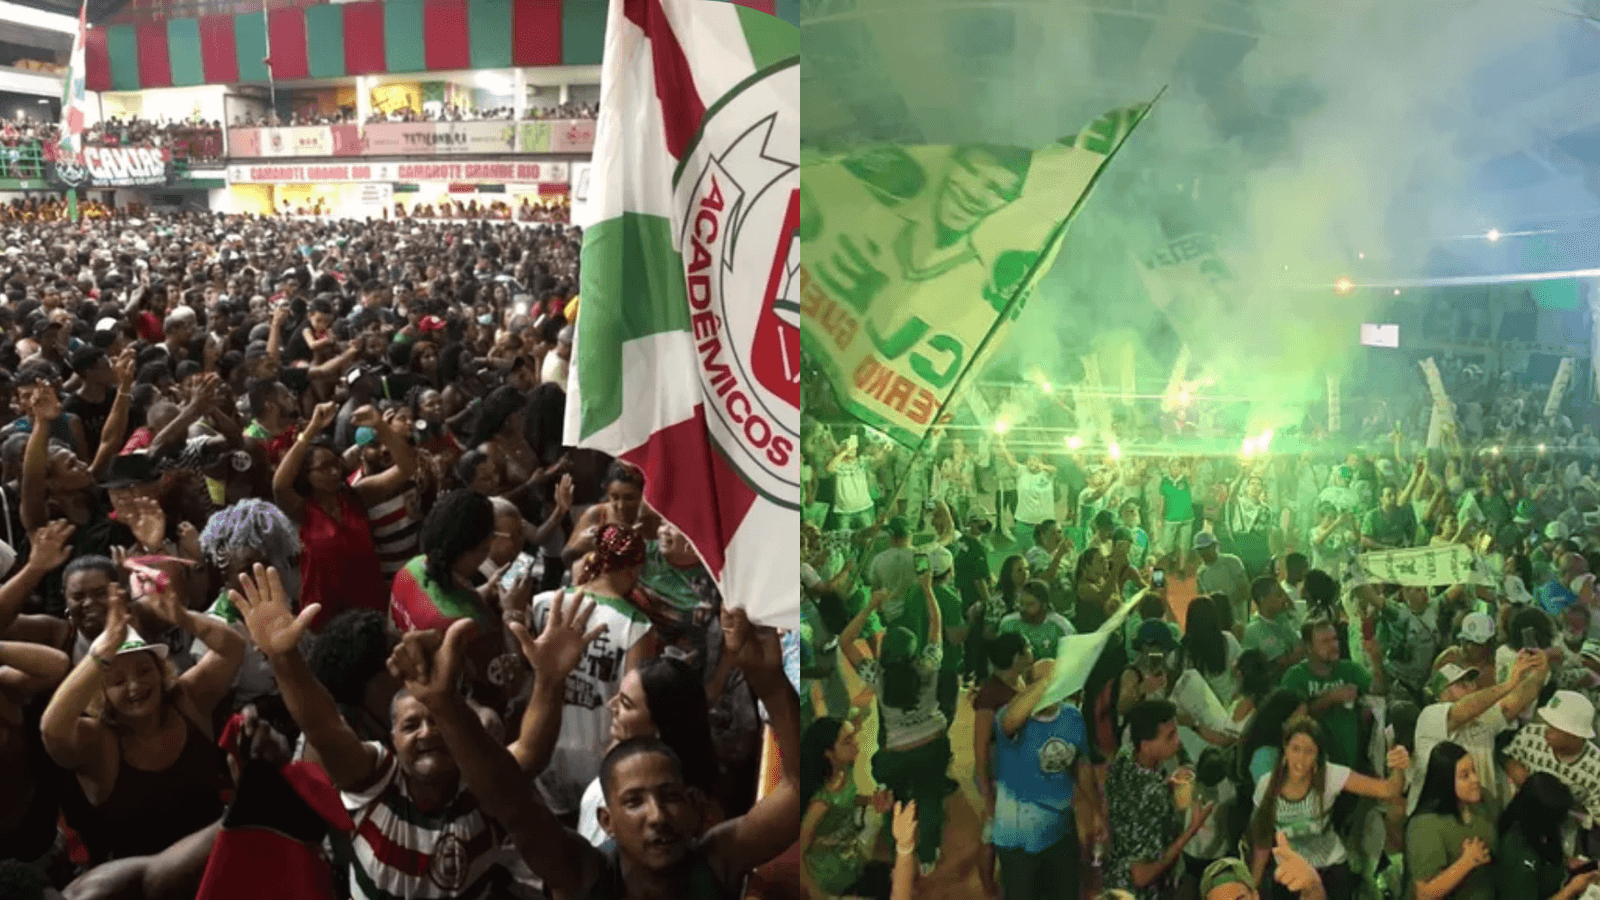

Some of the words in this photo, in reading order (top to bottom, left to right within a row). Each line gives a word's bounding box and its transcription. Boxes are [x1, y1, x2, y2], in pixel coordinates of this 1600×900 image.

[83, 146, 165, 179] CAXIAS
[398, 164, 462, 179] CAMAROTE
[517, 164, 540, 179] RIO
[688, 175, 794, 467] ACADÊMICOS
